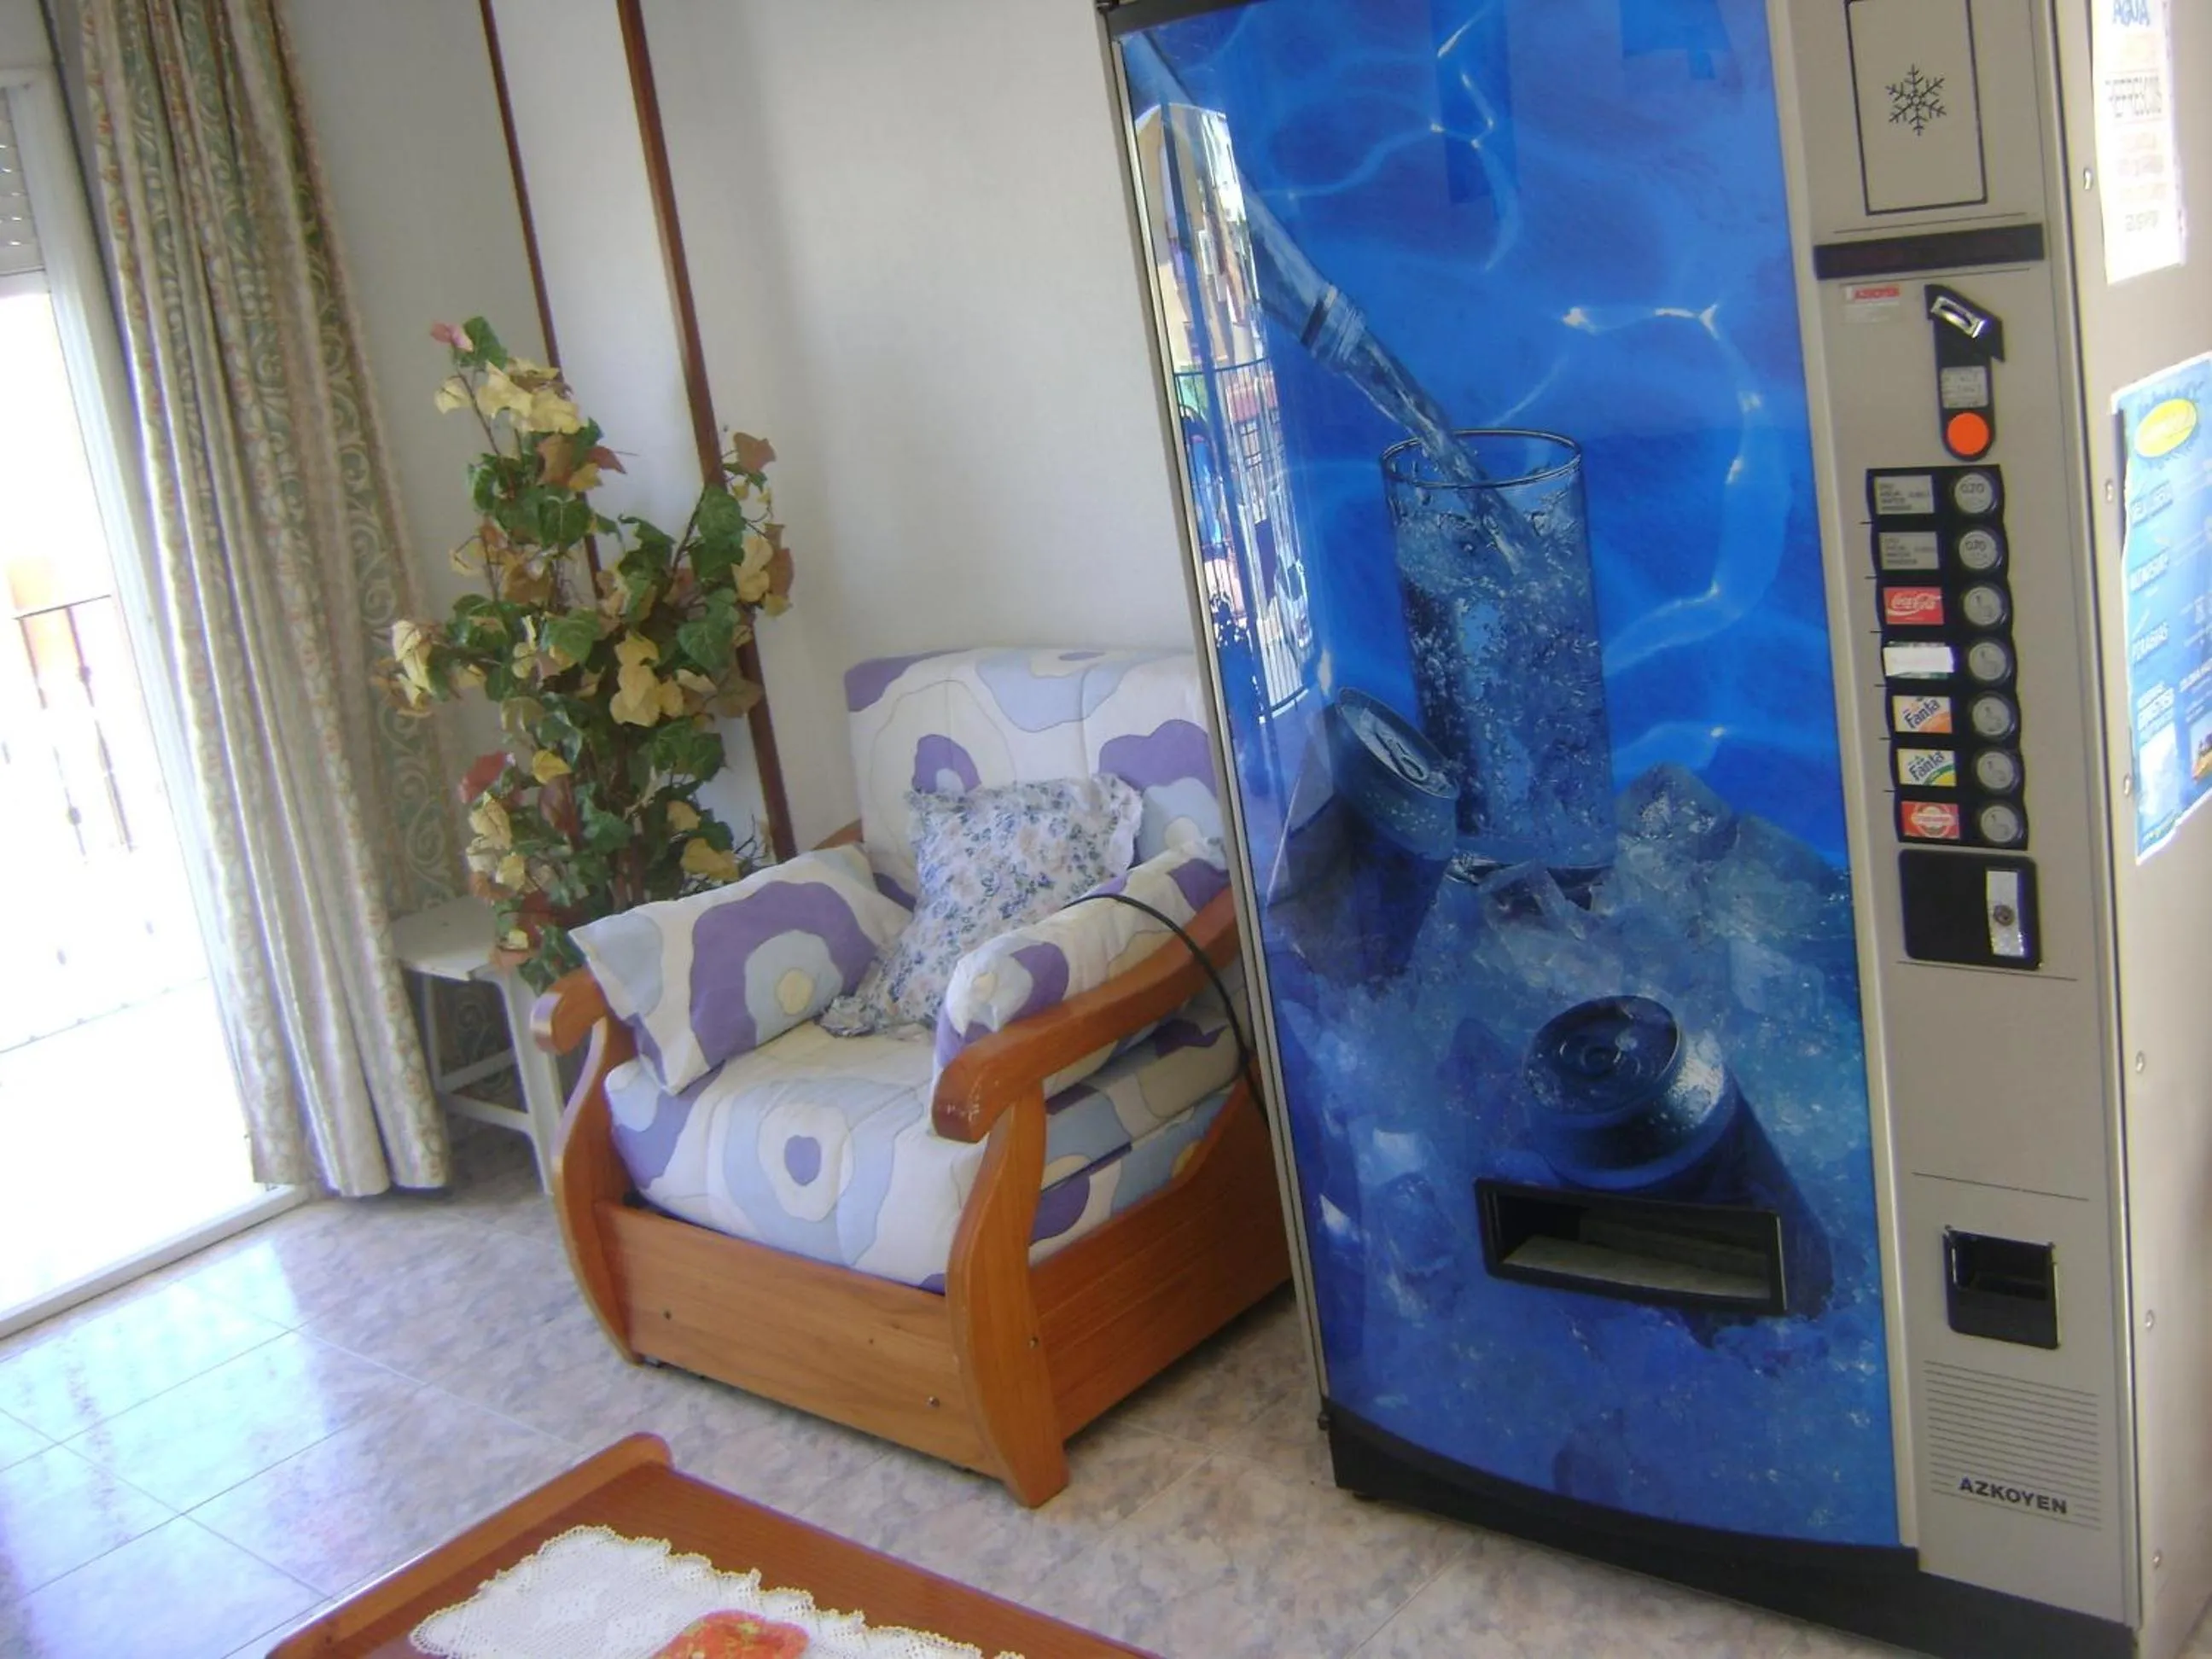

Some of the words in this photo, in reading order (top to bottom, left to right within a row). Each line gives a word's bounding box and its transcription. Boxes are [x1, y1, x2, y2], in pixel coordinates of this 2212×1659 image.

[1903, 697, 1941, 729] Fanta
[1908, 750, 1945, 782] Fanta
[1959, 1476, 2068, 1515] AZKOYEN
